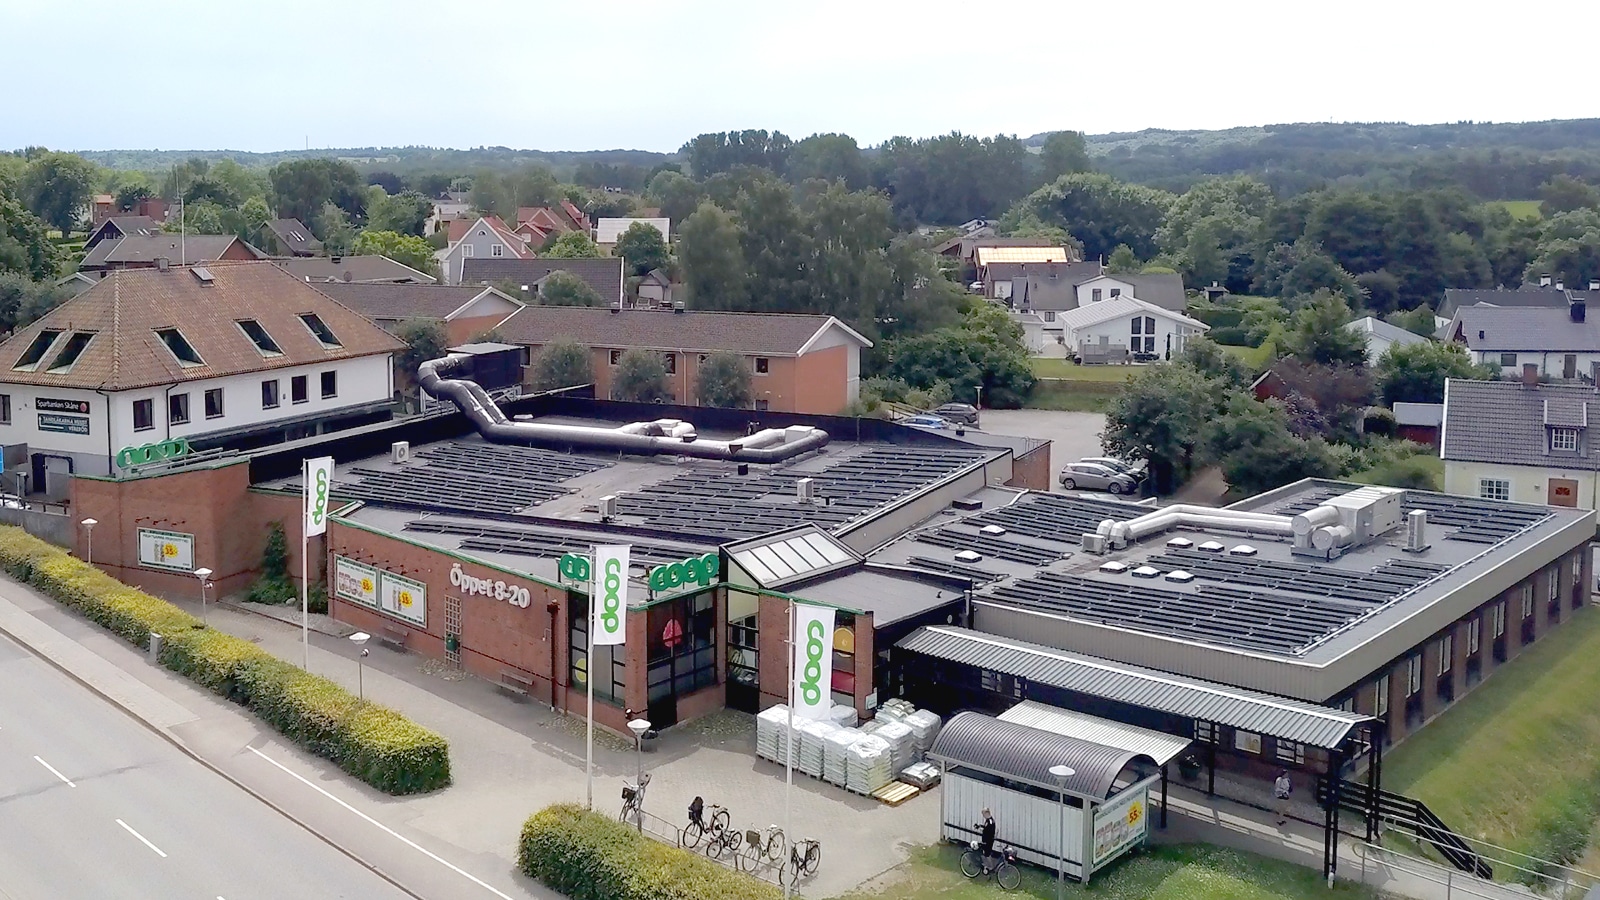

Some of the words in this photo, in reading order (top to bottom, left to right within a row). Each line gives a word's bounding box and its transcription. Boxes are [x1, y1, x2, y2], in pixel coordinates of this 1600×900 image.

[312, 468, 327, 526] coop
[450, 563, 495, 597] Öppet
[494, 580, 531, 608] 8-20
[600, 558, 621, 633] coop
[649, 553, 719, 592] coop
[800, 619, 825, 706] coop
